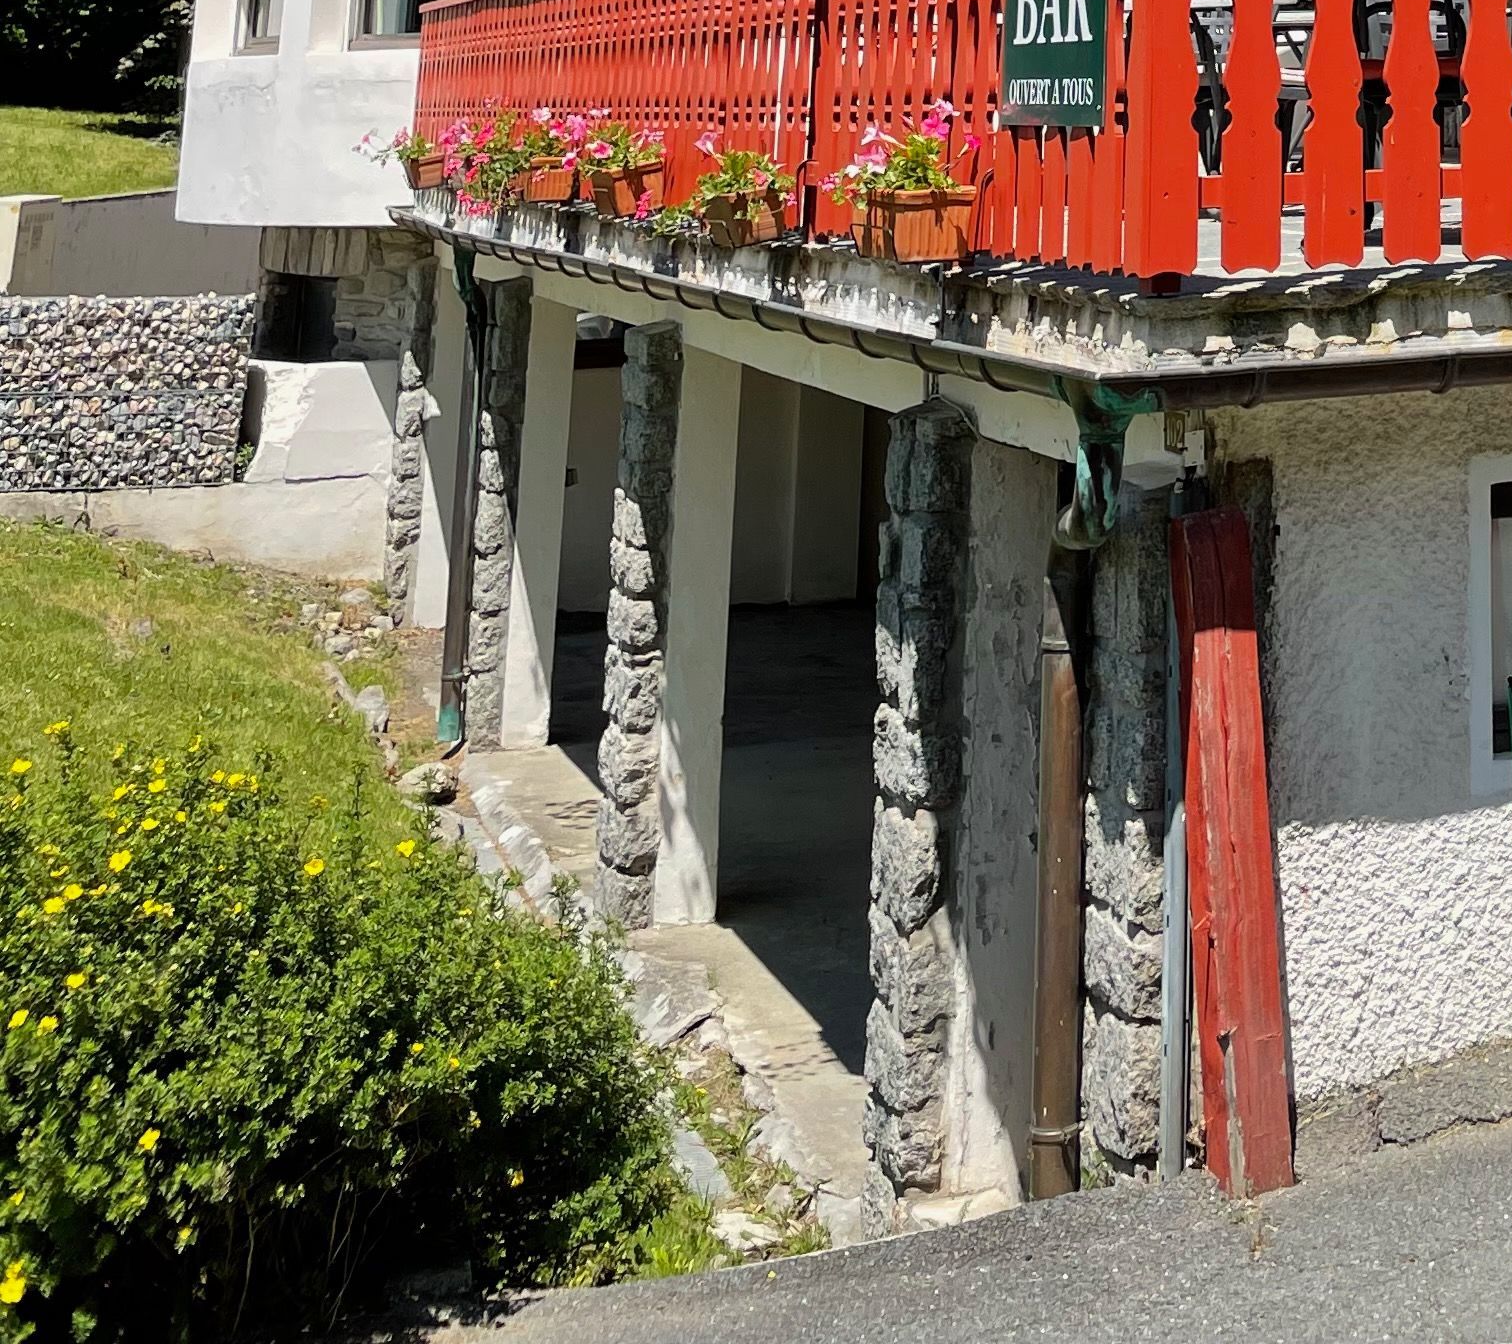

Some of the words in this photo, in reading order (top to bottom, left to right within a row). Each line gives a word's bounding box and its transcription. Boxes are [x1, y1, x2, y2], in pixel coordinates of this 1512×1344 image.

[1008, 78, 1051, 106] OUVERT
[1051, 78, 1060, 105] A
[1062, 77, 1094, 106] TOUS
